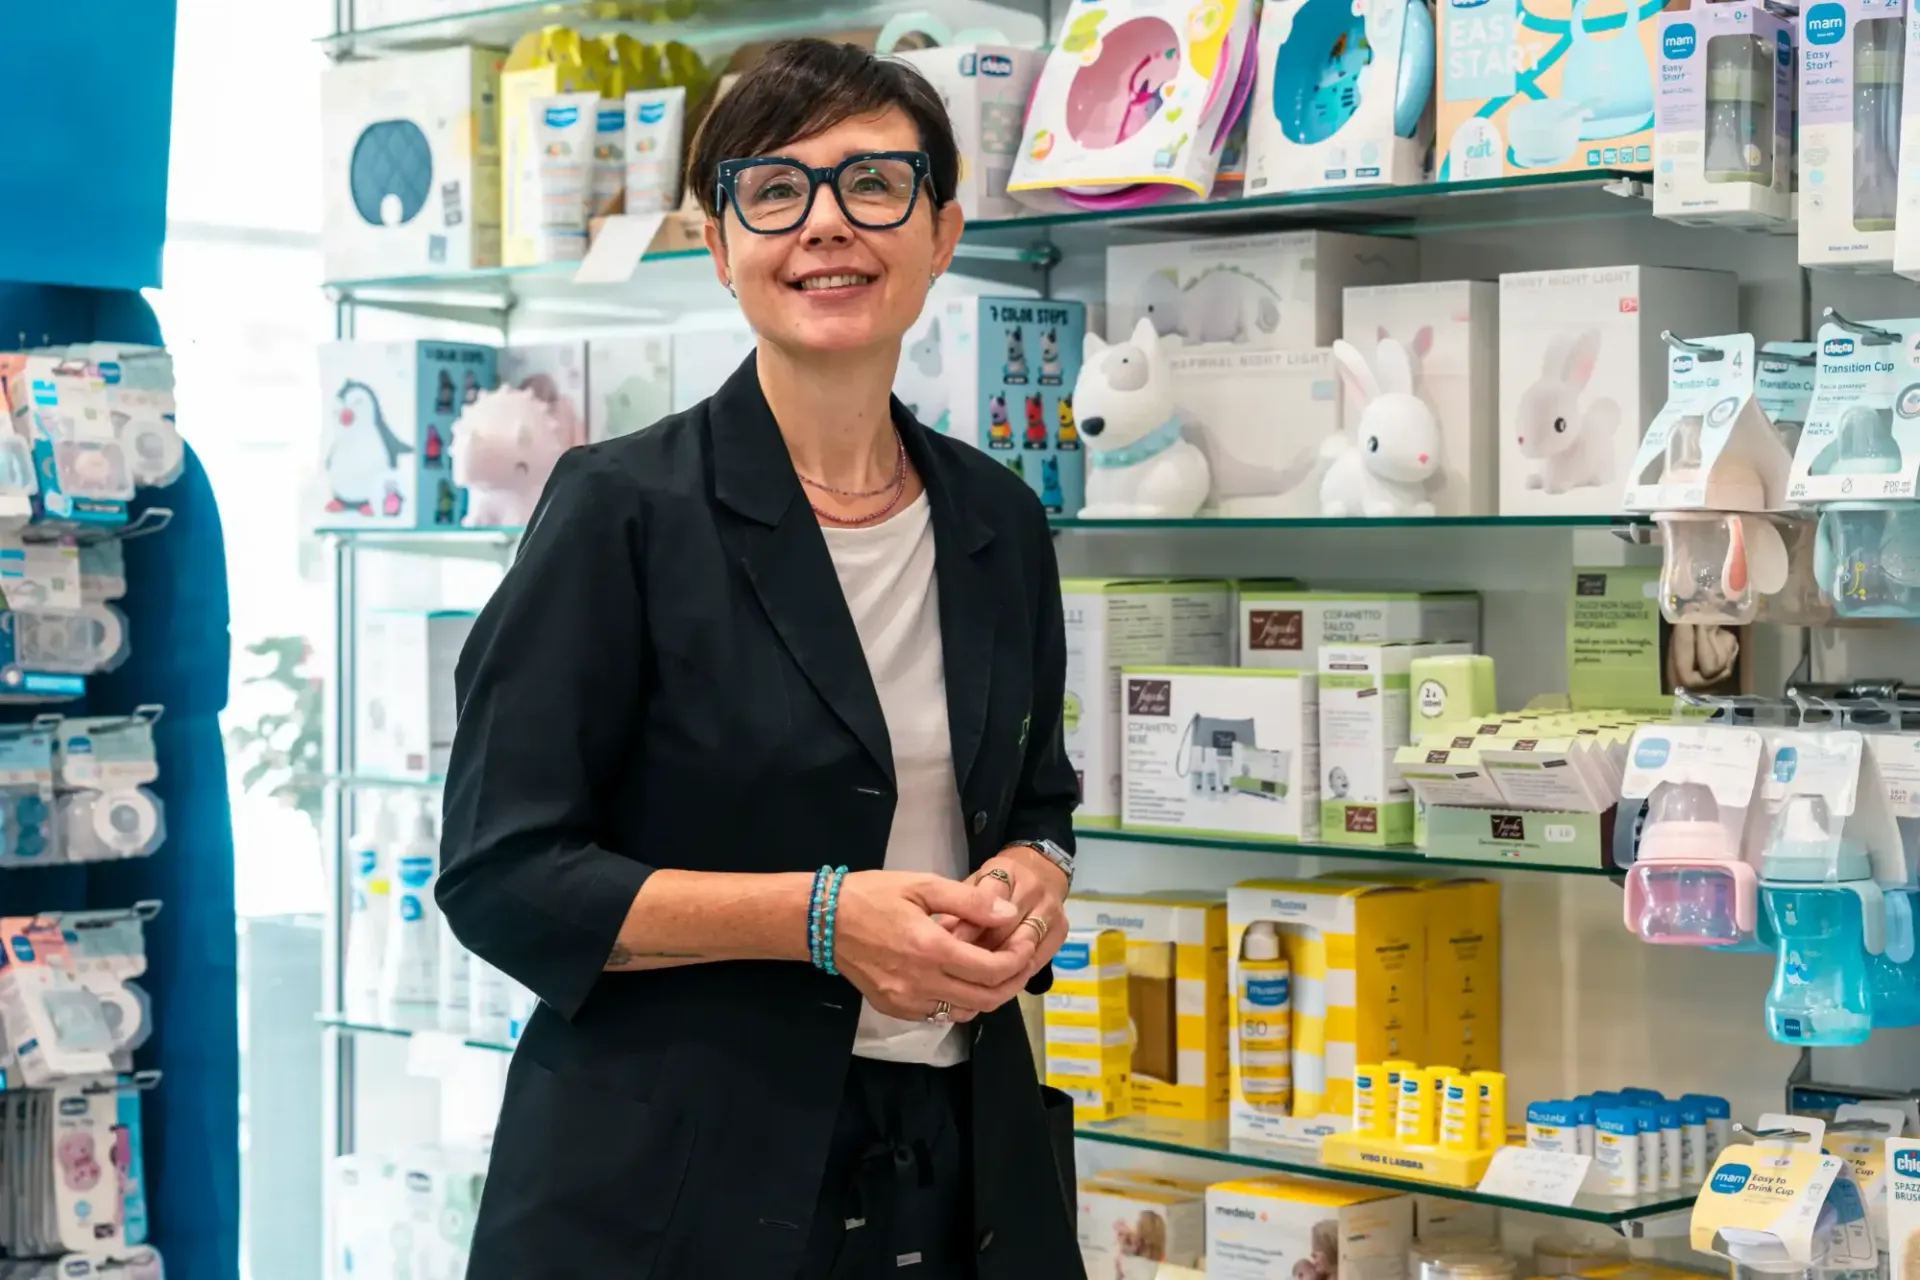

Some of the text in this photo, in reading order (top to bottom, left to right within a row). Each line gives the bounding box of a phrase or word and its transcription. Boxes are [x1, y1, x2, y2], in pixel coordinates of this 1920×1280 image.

[1734, 10, 1748, 21] 0+
[1449, 11, 1526, 47] EASY
[1808, 18, 1843, 30] mam
[1665, 35, 1694, 47] mam
[1449, 42, 1543, 79] START
[1806, 51, 1830, 60] Easy
[1662, 64, 1683, 73] Easy
[1806, 61, 1833, 71] Start
[1662, 72, 1686, 82] Start
[1548, 273, 1590, 286] NIGHT
[1593, 271, 1632, 284] LIGHT
[1001, 306, 1032, 323] COLOR
[1037, 308, 1068, 325] STEPS
[1825, 339, 1853, 354] chicco
[1287, 352, 1330, 365] LIGHT
[1732, 350, 1743, 369] 4
[1822, 361, 1895, 373] Transition Cup
[1759, 379, 1814, 392] Transition Cu
[1323, 609, 1382, 620] COFANETTO
[1323, 620, 1355, 631] TALCO
[1425, 688, 1431, 698] 2
[1127, 722, 1178, 735] COFANETTO
[1245, 1019, 1268, 1036] 50
[1360, 1152, 1424, 1170] VISO E LABBRA
[1897, 1152, 1920, 1172] chi
[1855, 1167, 1875, 1176] Cup
[1715, 1173, 1746, 1184] mam
[1752, 1174, 1787, 1184] Easy to
[1747, 1183, 1795, 1196] Drink Cup
[1215, 1206, 1256, 1221] medela
